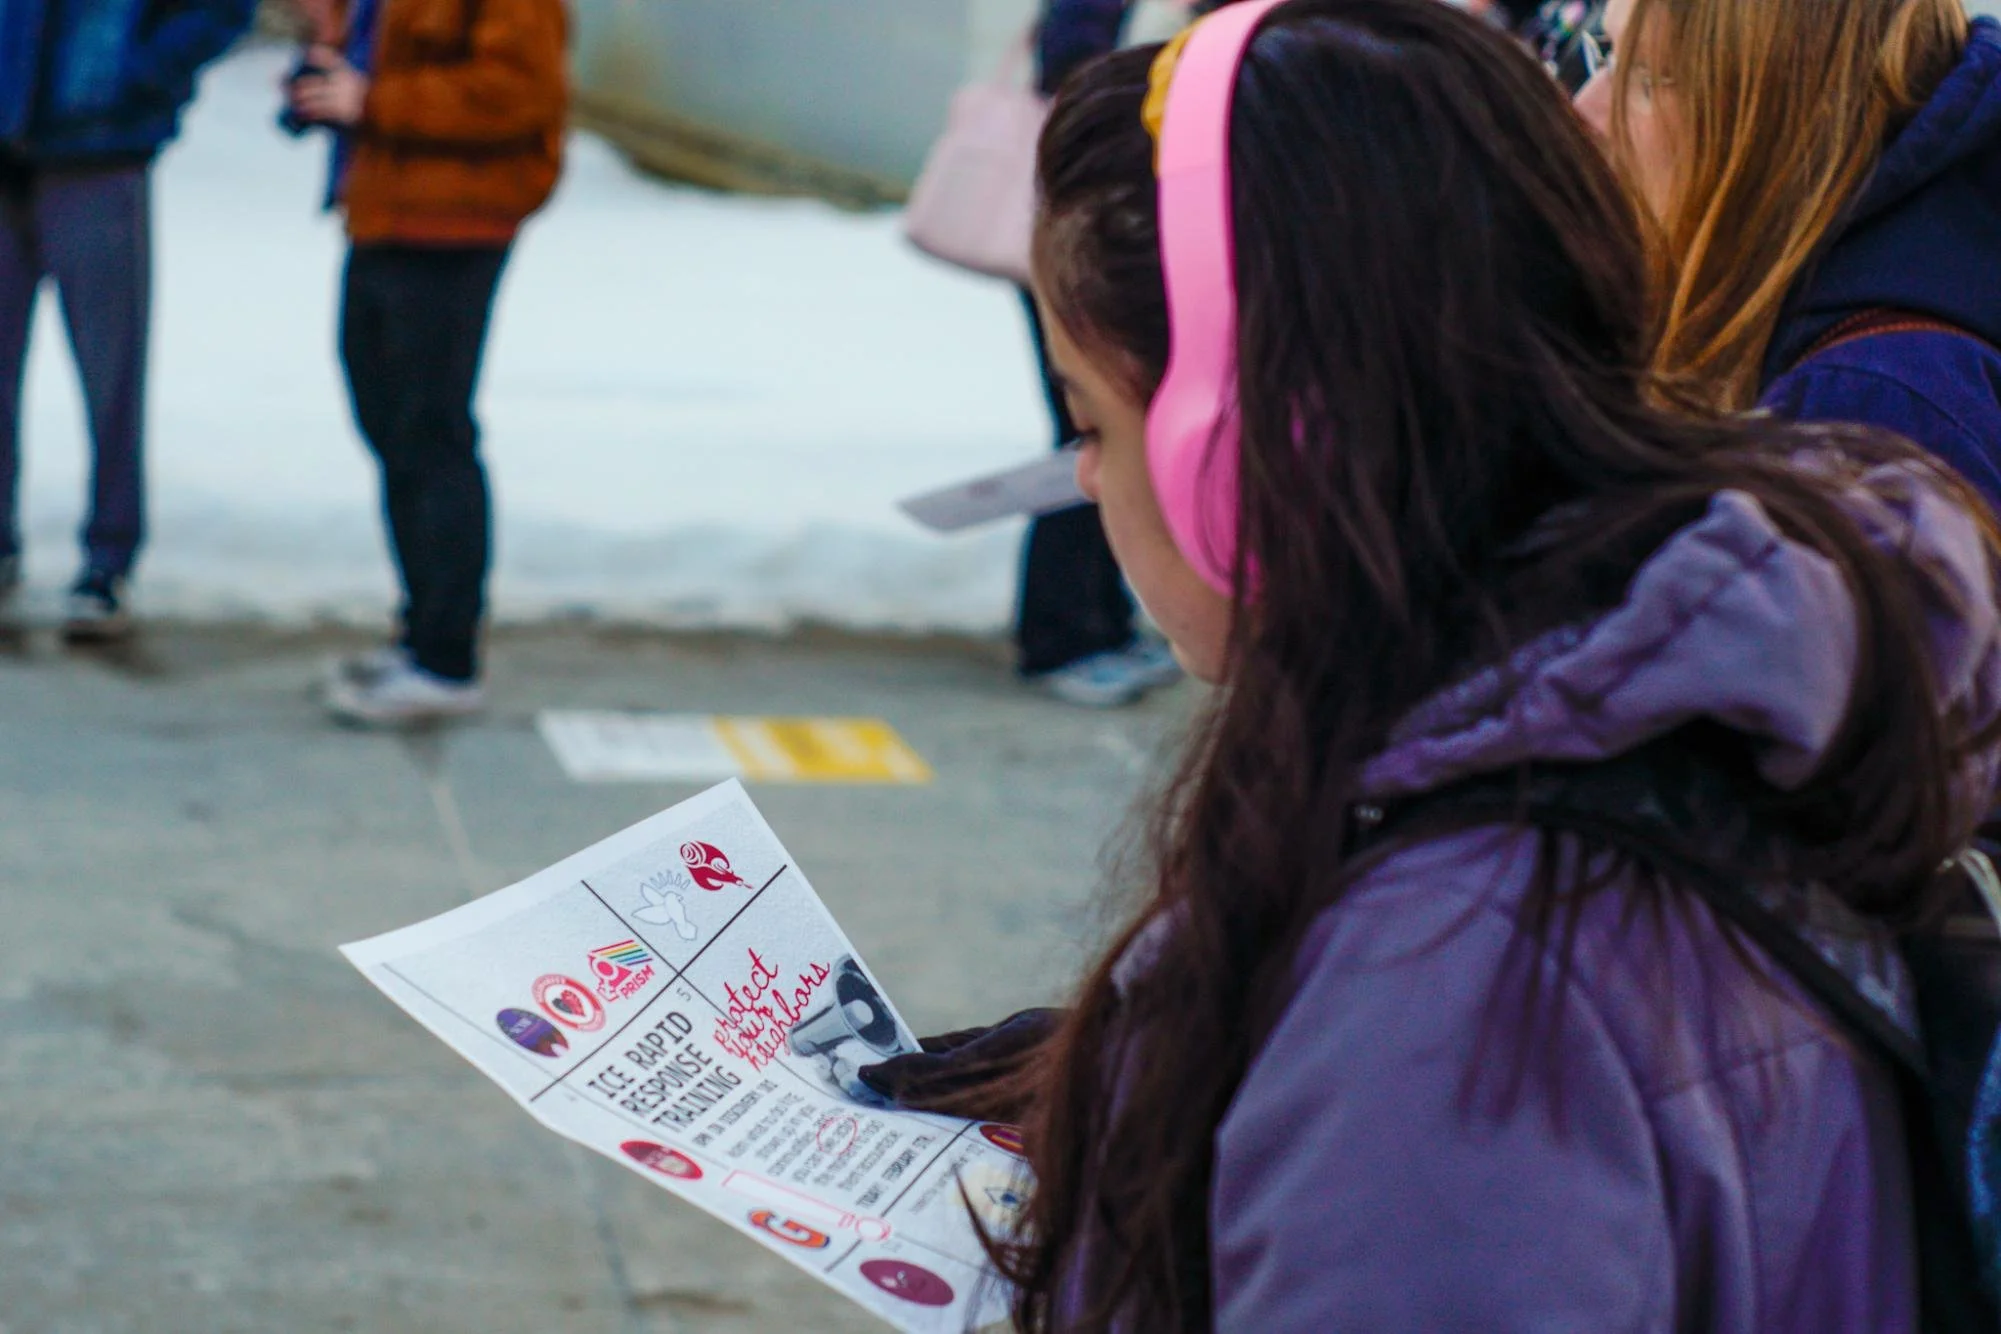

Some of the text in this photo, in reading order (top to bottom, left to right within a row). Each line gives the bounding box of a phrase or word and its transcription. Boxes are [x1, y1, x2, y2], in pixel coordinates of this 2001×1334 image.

[620, 964, 655, 999] PRISM
[676, 987, 691, 1002] 5
[713, 947, 778, 1053] protect
[586, 1065, 635, 1099] ICE
[624, 1011, 693, 1070] RAPID
[619, 1043, 713, 1117] RESPONSE
[652, 1065, 742, 1133] TRAINING
